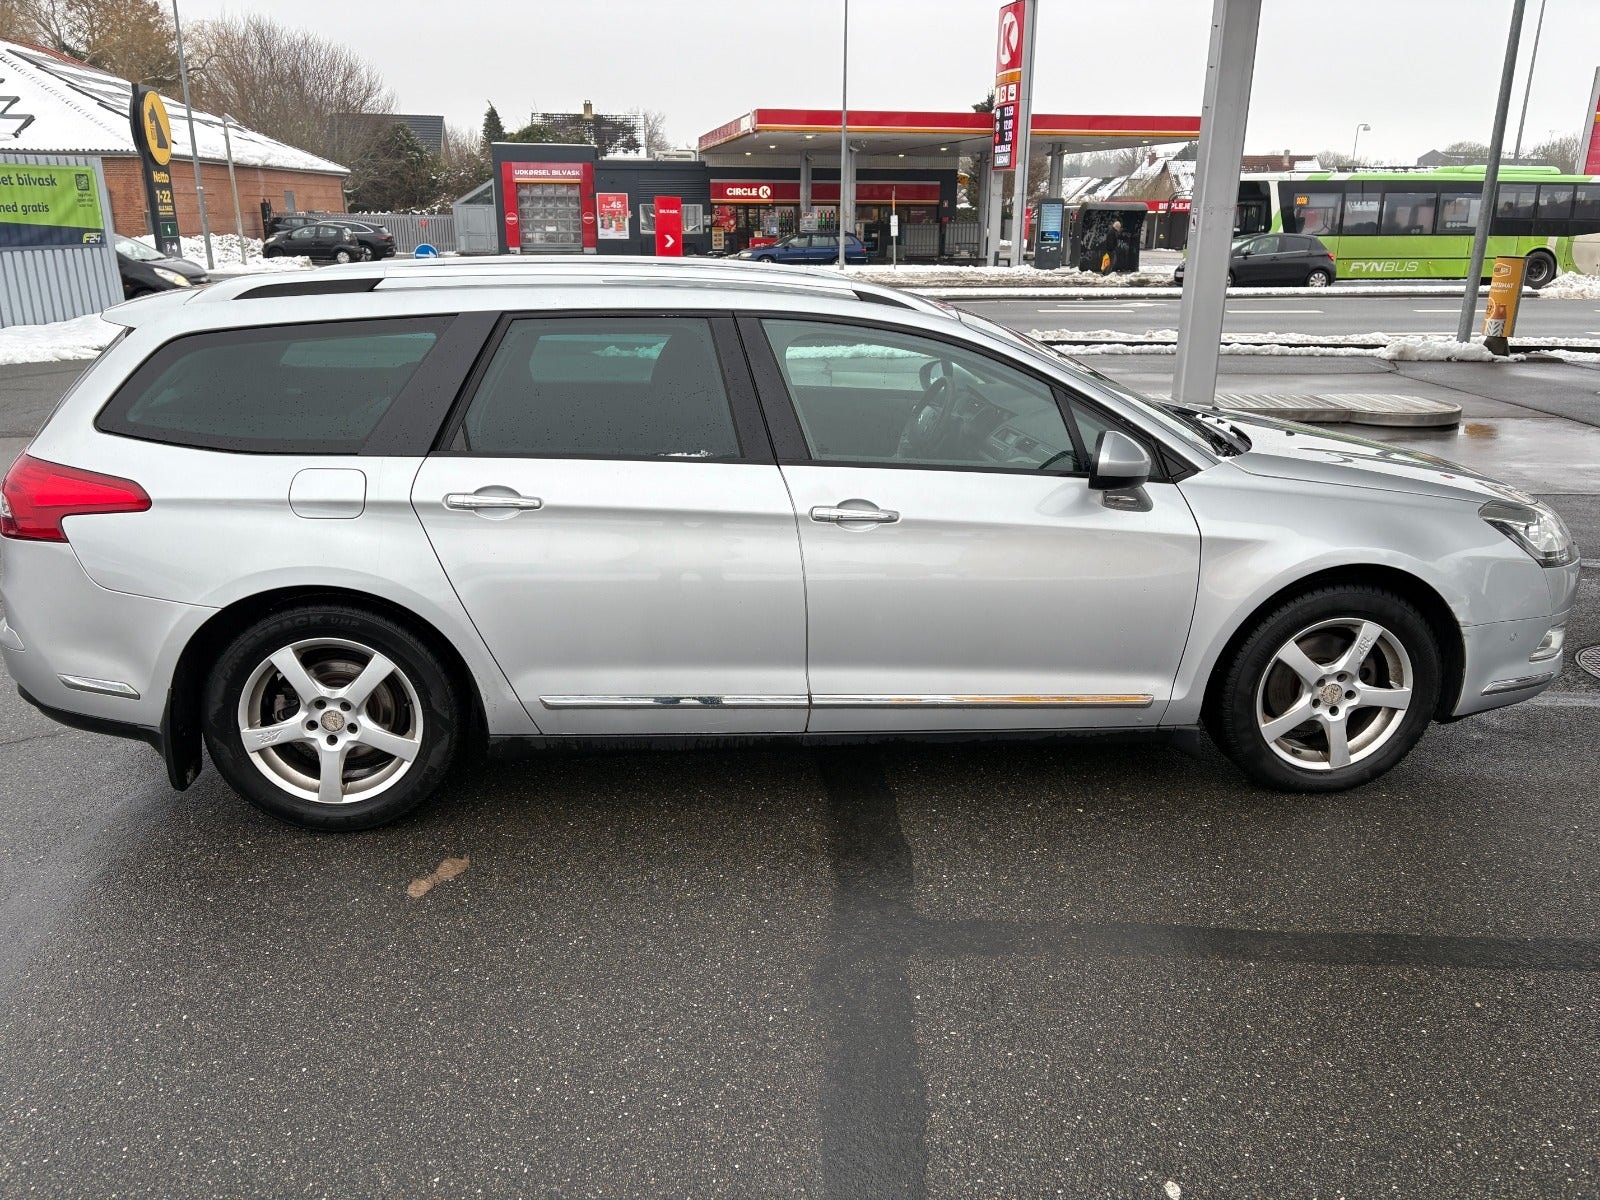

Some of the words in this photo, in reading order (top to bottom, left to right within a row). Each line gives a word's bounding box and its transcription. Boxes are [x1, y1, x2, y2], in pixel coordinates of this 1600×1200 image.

[16, 173, 58, 187] bilvask
[152, 171, 170, 184] Netto
[726, 188, 758, 196] CIRCLE
[21, 202, 50, 216] gratis
[82, 232, 101, 244] F24
[1349, 261, 1419, 272] FYNBUS
